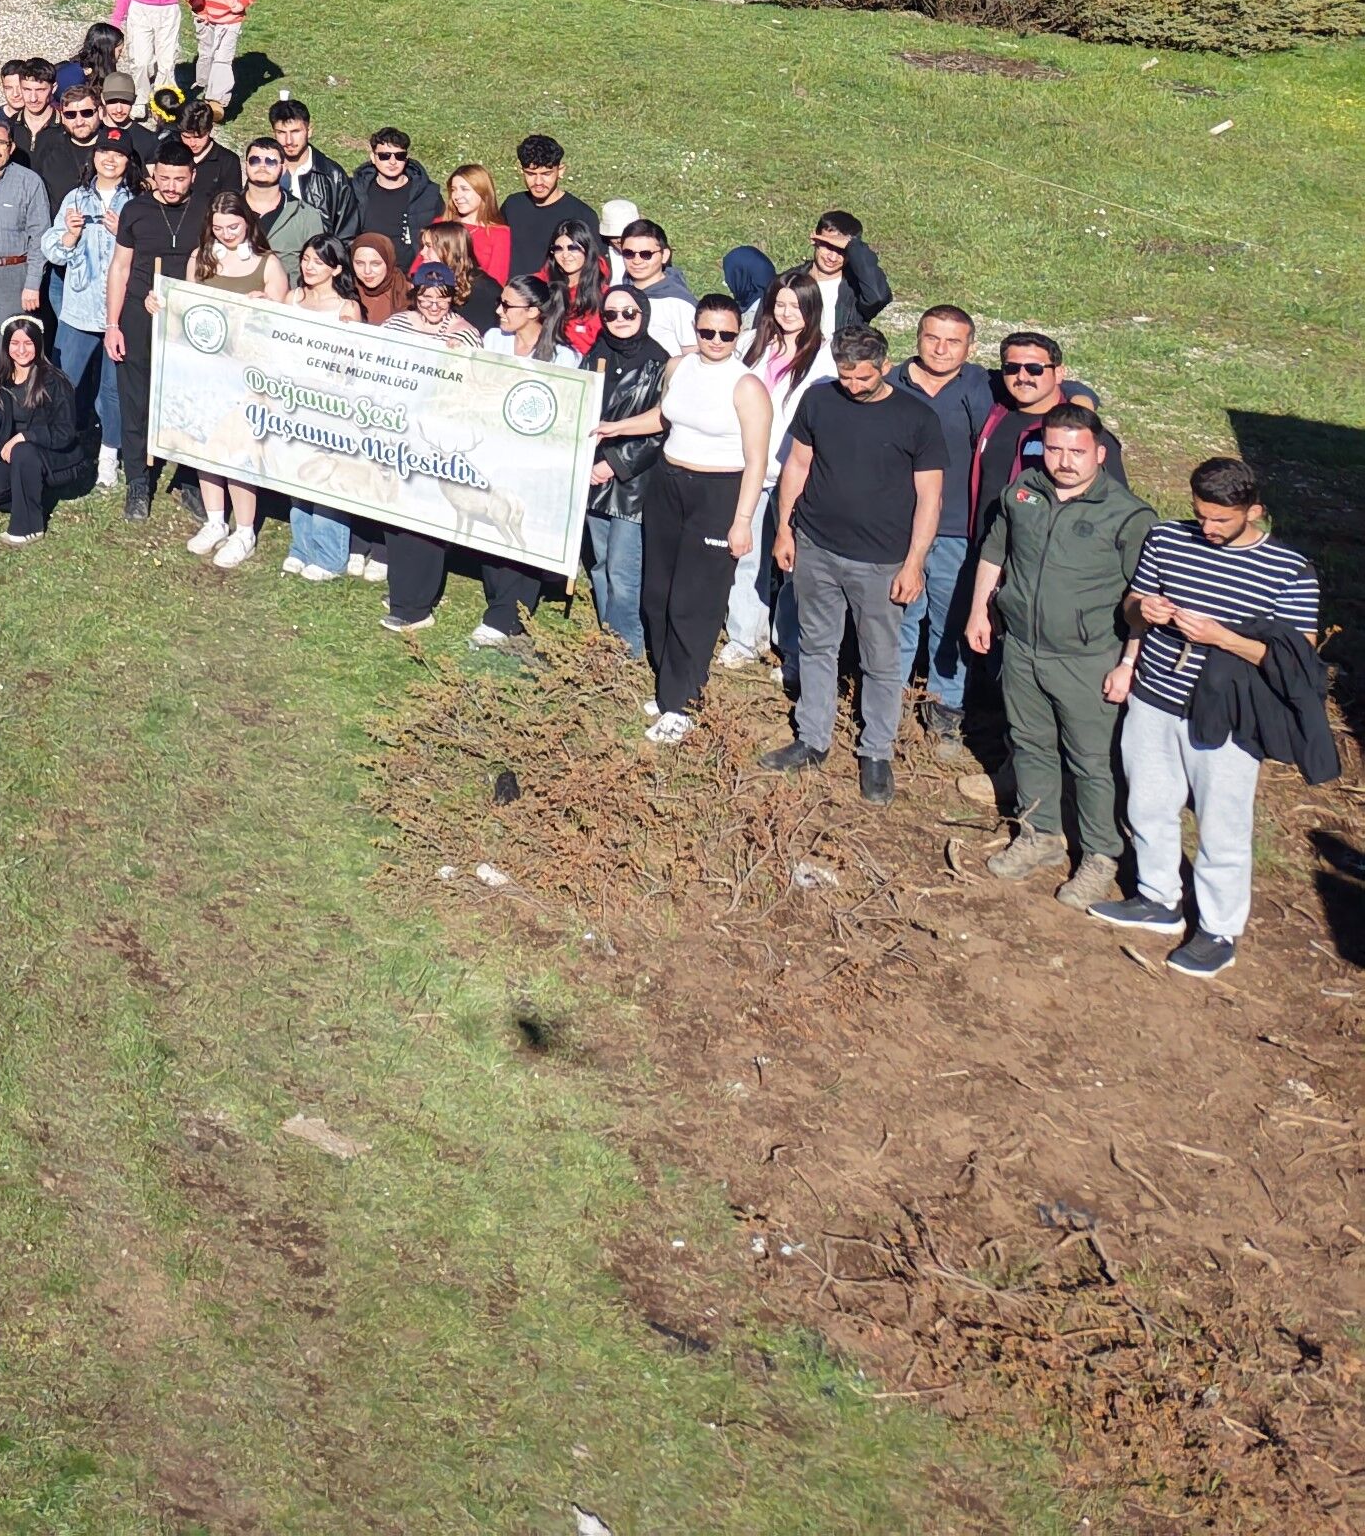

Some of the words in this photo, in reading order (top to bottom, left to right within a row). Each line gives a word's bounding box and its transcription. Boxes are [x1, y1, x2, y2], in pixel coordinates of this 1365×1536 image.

[271, 330, 303, 345] DOĞA
[306, 339, 355, 358] KORUMA
[358, 350, 373, 362] VE
[375, 354, 409, 371] MİLLİ
[412, 364, 463, 383] PARKLAR
[306, 357, 342, 374] GENEL
[345, 366, 418, 391] MÜDÜRLÜĞÜ
[245, 369, 351, 416] Doğanın
[355, 398, 406, 431] Sesi
[245, 403, 354, 452] Yaşamın
[361, 436, 487, 486] Nefesidir.
